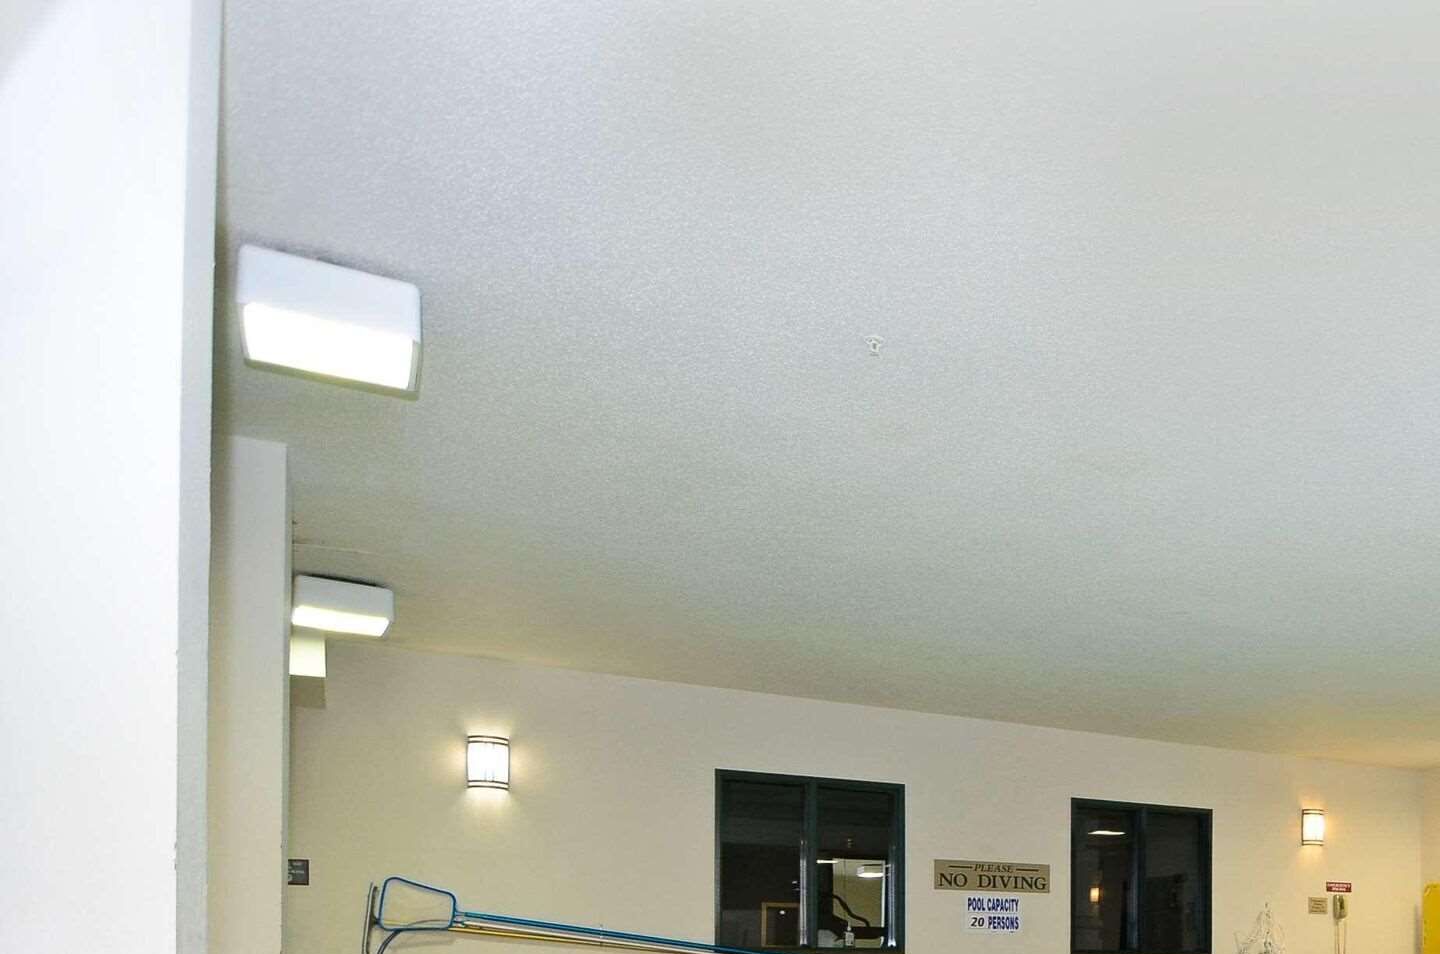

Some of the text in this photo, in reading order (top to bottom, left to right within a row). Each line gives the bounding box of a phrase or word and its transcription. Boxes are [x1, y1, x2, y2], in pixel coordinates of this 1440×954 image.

[974, 863, 1014, 873] PLEASE
[938, 872, 1047, 890] NO DIVING
[967, 897, 1019, 912] POOL CAPACITY
[970, 915, 1019, 930] 20 PERSONS
